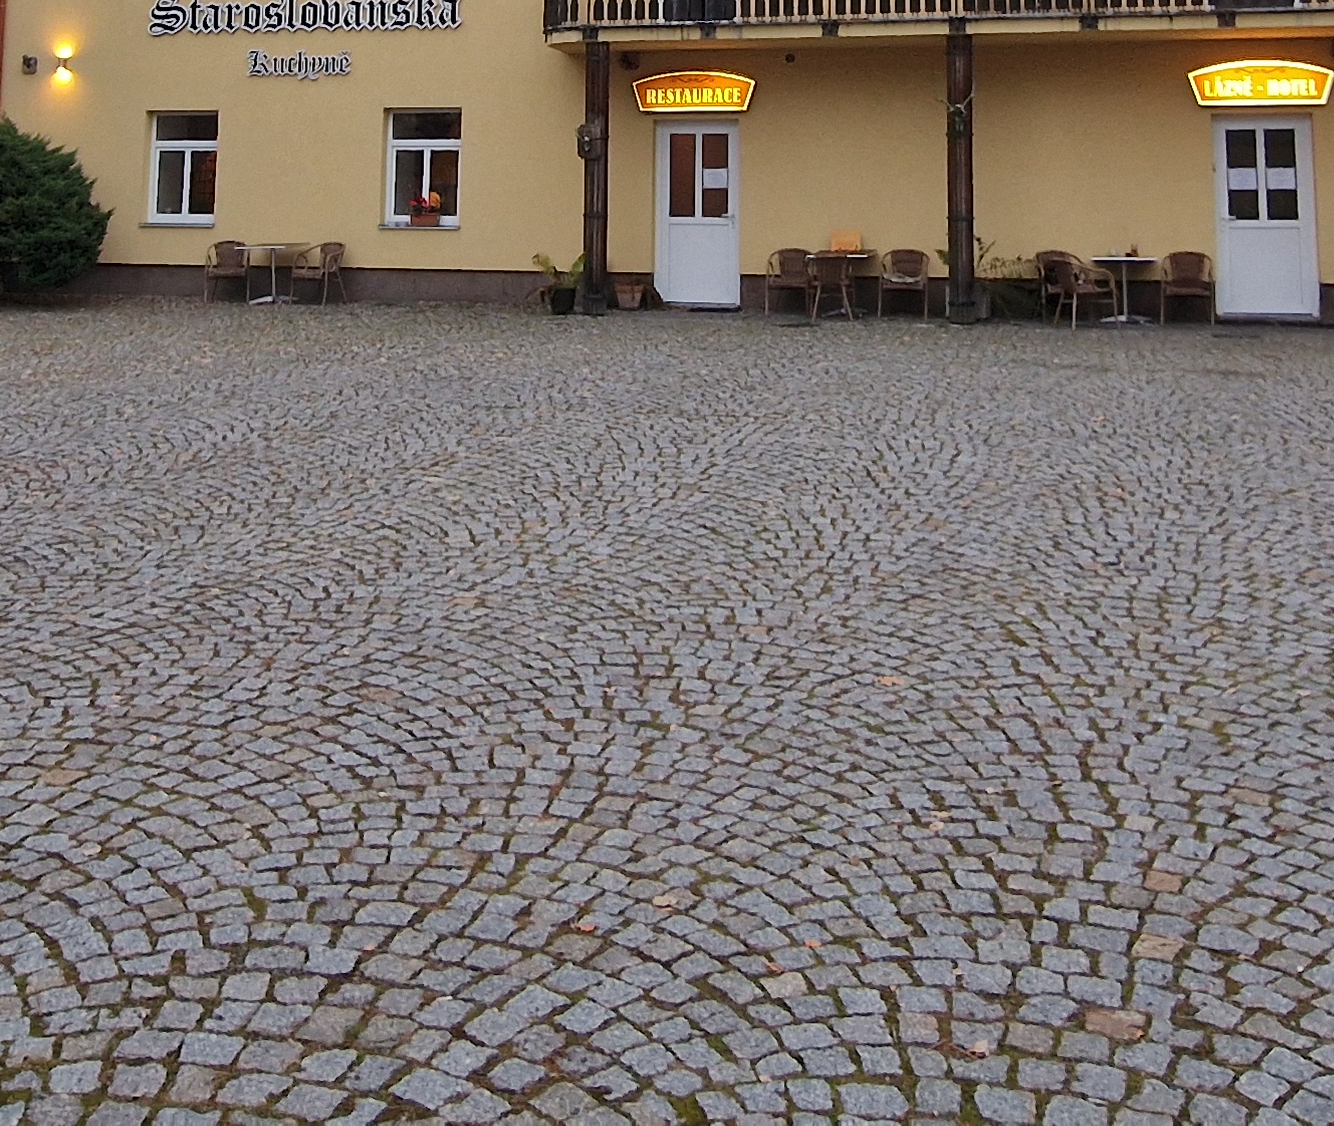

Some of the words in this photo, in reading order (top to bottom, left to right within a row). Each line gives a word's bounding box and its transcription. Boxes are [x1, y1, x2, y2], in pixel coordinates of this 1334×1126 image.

[247, 50, 352, 80] Kuchyně
[646, 87, 742, 104] RESTAURACE
[1267, 78, 1318, 97] HOTEL
